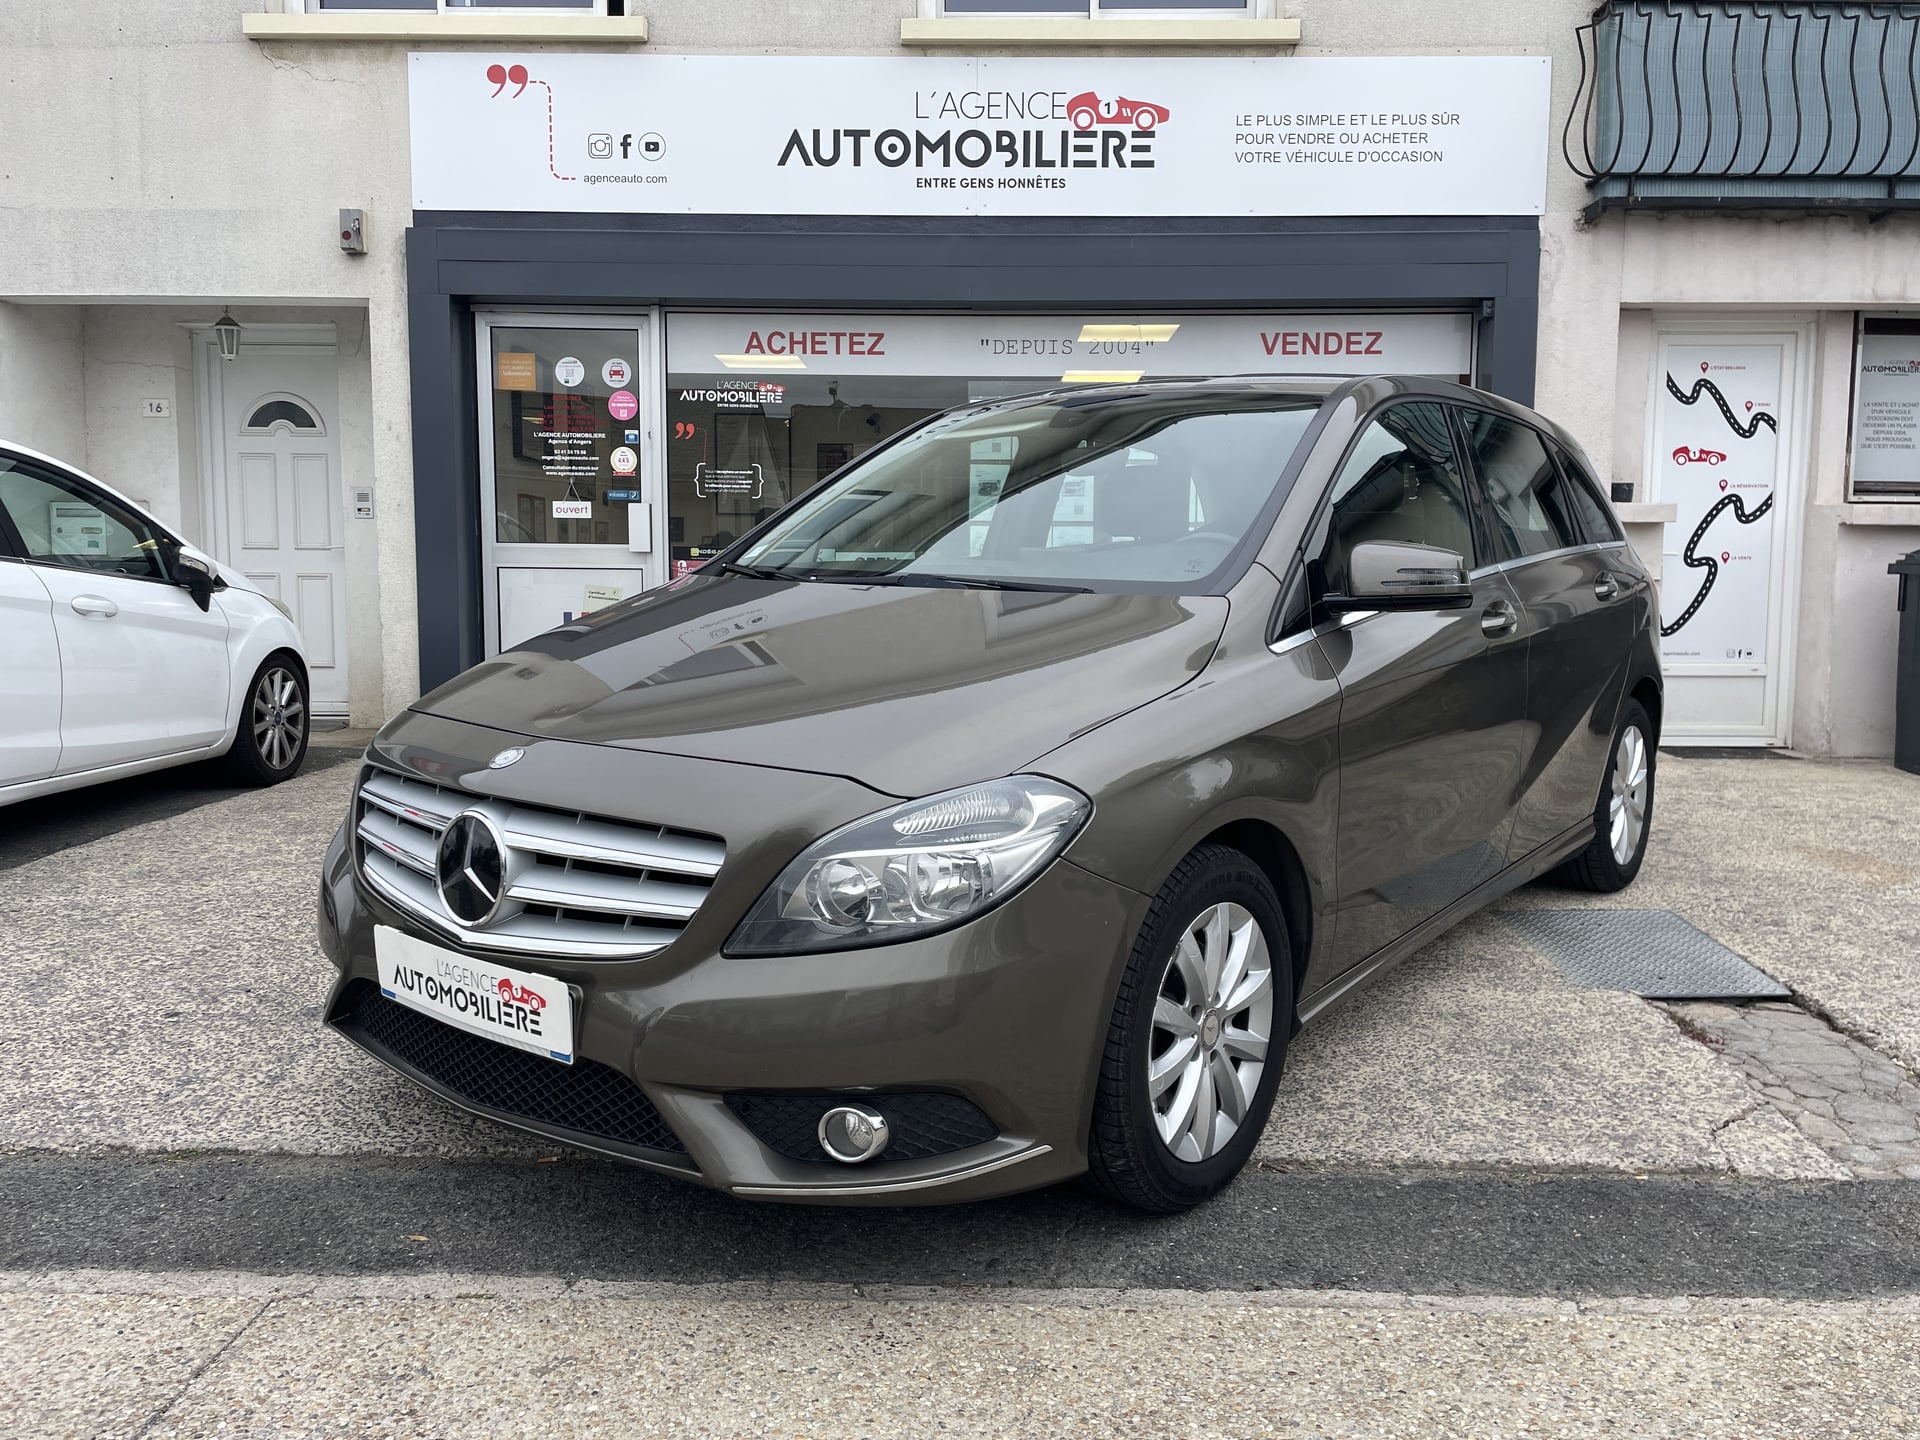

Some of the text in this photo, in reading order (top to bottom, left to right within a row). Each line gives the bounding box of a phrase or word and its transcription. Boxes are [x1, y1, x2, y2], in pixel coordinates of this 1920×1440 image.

[916, 91, 1067, 120] L'AGENCE
[1236, 112, 1460, 126] LE PLUS SIMPLE ET LE PLUS SÛR
[1235, 132, 1428, 144] POUR VENDRE OU ACHETER
[777, 128, 1156, 168] AUTOMOBILIERE
[1235, 149, 1443, 163] VOTRE VÉHICULE D'OCCASION
[583, 174, 668, 185] agenceauto.com
[916, 175, 1066, 189] ENTRE GENS HONNÊTES
[744, 331, 886, 355] ACHETEZ
[1260, 332, 1383, 355] VENDEZ
[716, 381, 758, 390] L'AGENCE
[680, 390, 783, 403] AUTOMOBILIERE
[149, 402, 162, 413] 16
[555, 506, 588, 514] ouvert
[436, 958, 499, 995] L'AGENCE
[394, 964, 543, 1036] AUTOMOBILIERE
